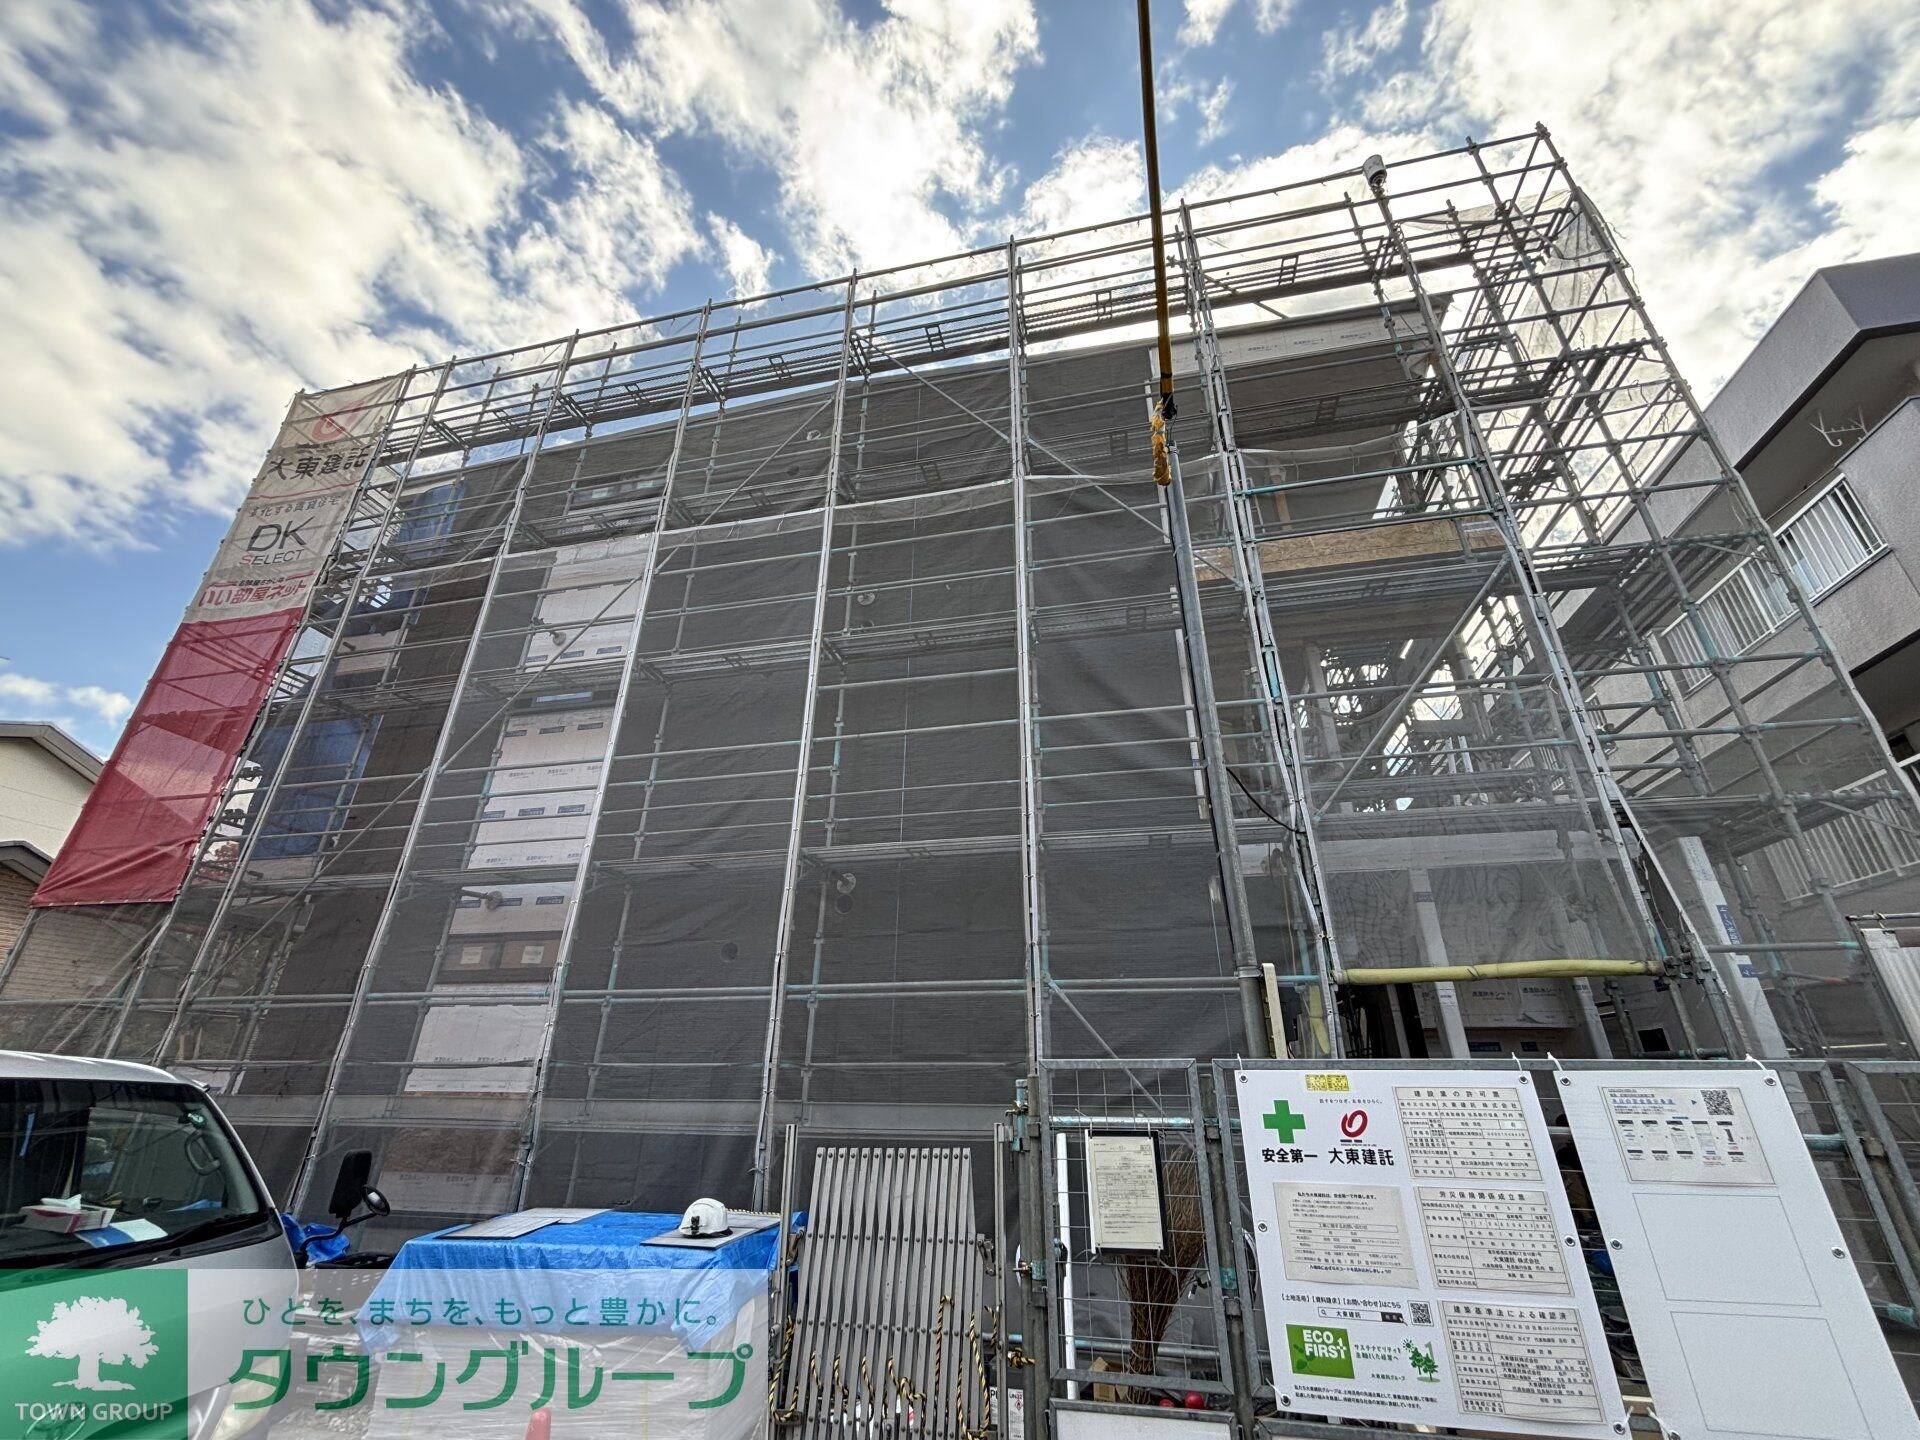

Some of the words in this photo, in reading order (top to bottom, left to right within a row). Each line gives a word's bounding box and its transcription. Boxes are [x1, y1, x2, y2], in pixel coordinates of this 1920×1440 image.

[262, 445, 372, 481] 大東建託
[248, 516, 315, 551] DK
[239, 549, 304, 565] SELECT
[199, 582, 306, 607] いい部屋ネット
[1262, 1147, 1318, 1164] 安全第一
[1328, 1148, 1395, 1166] 大東建託
[1439, 1191, 1525, 1201] 労災保険関係成立票
[1336, 1311, 1361, 1319] 大東建託
[1453, 1305, 1567, 1320] 建築基準法による確認済
[1302, 1329, 1334, 1344] ECO
[1304, 1337, 1347, 1359] FIRST
